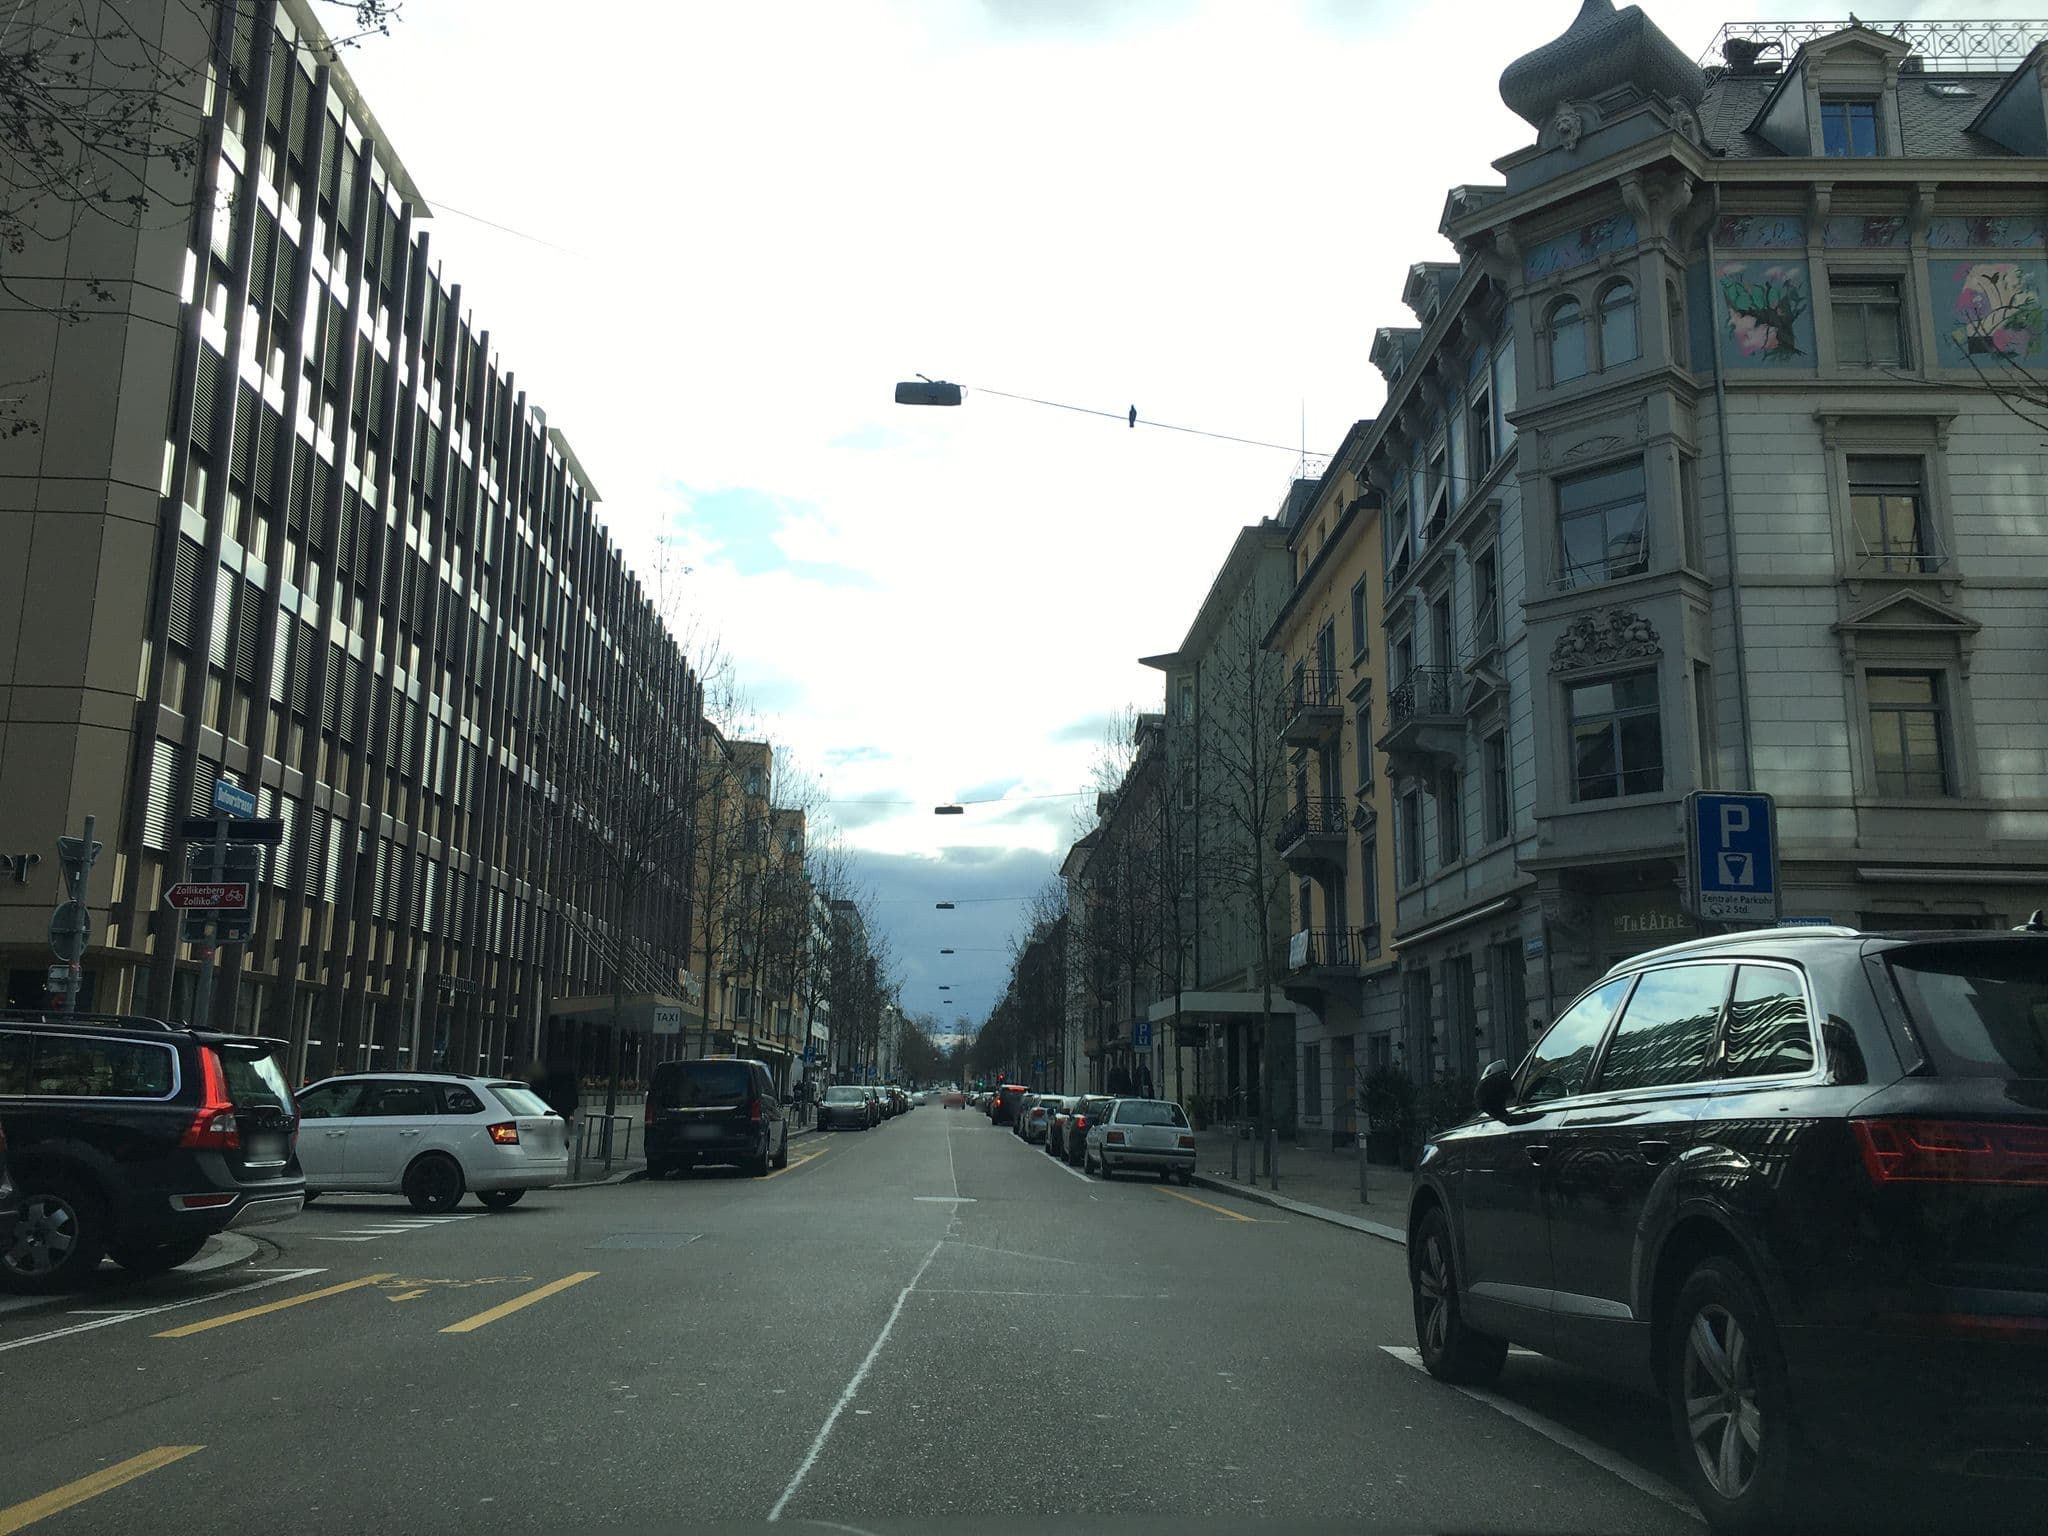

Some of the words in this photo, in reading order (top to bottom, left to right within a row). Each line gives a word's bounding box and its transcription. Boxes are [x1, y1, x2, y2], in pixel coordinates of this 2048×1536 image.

[1720, 804, 1750, 848] P
[176, 886, 225, 897] Zollikerberg
[183, 897, 216, 905] Zolliko
[1702, 894, 1738, 903] Zentrale
[656, 1012, 678, 1022] TAXI
[1139, 1023, 1148, 1035] P
